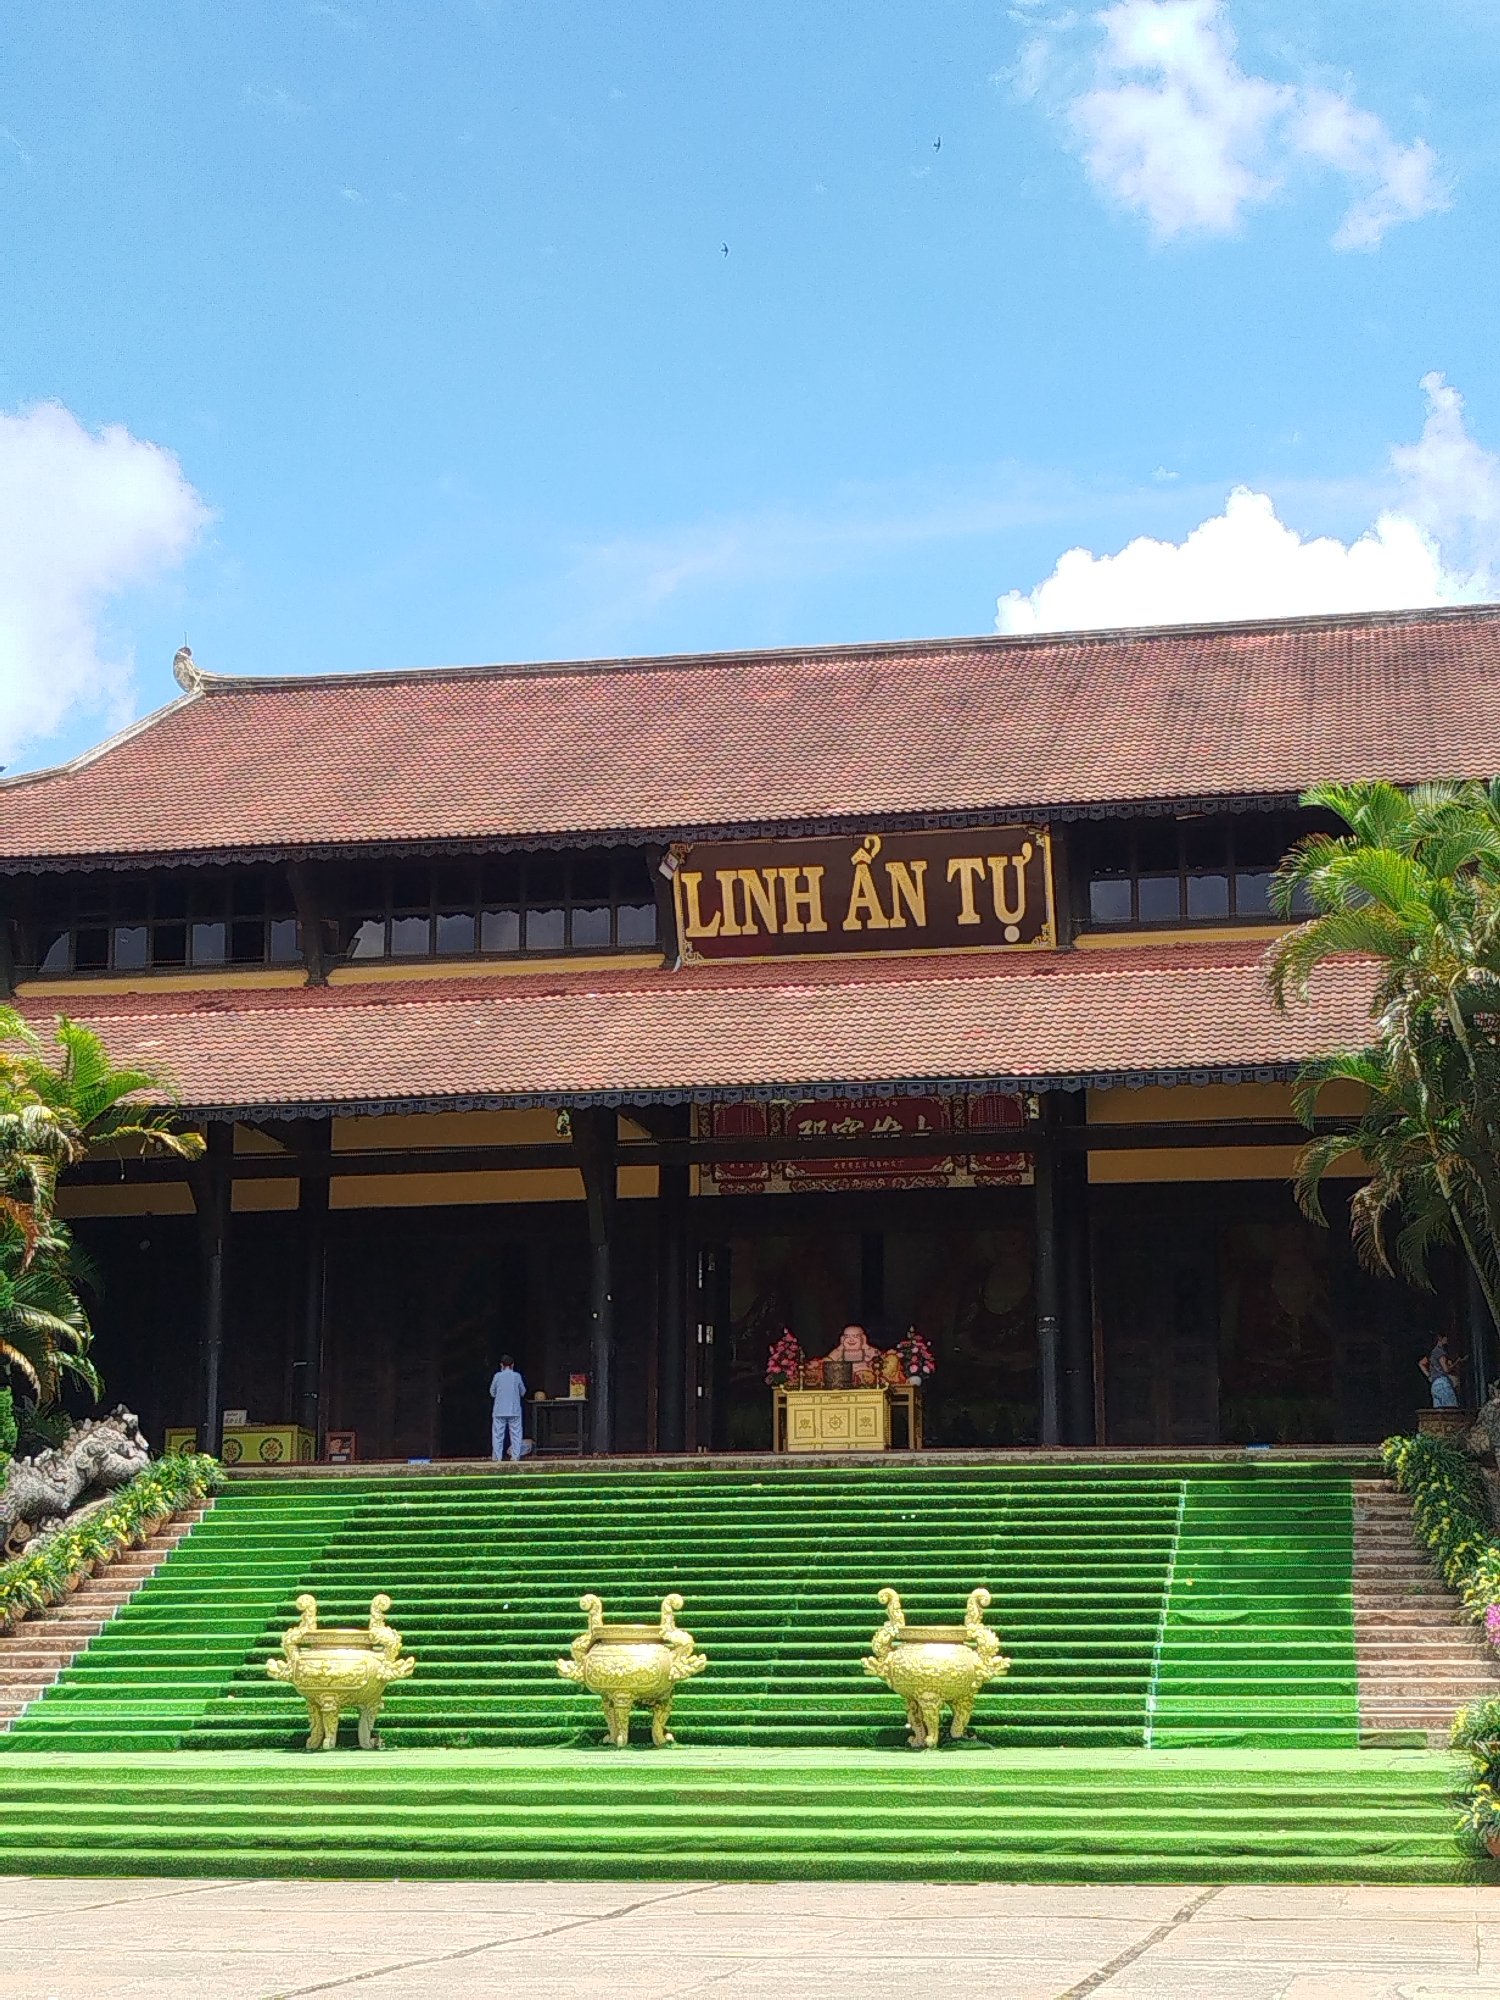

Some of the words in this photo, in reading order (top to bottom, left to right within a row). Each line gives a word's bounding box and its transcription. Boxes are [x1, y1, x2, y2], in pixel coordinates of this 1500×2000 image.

[680, 865, 828, 938] LINH
[842, 834, 928, 931] ẨN
[947, 841, 1033, 943] TỰ
